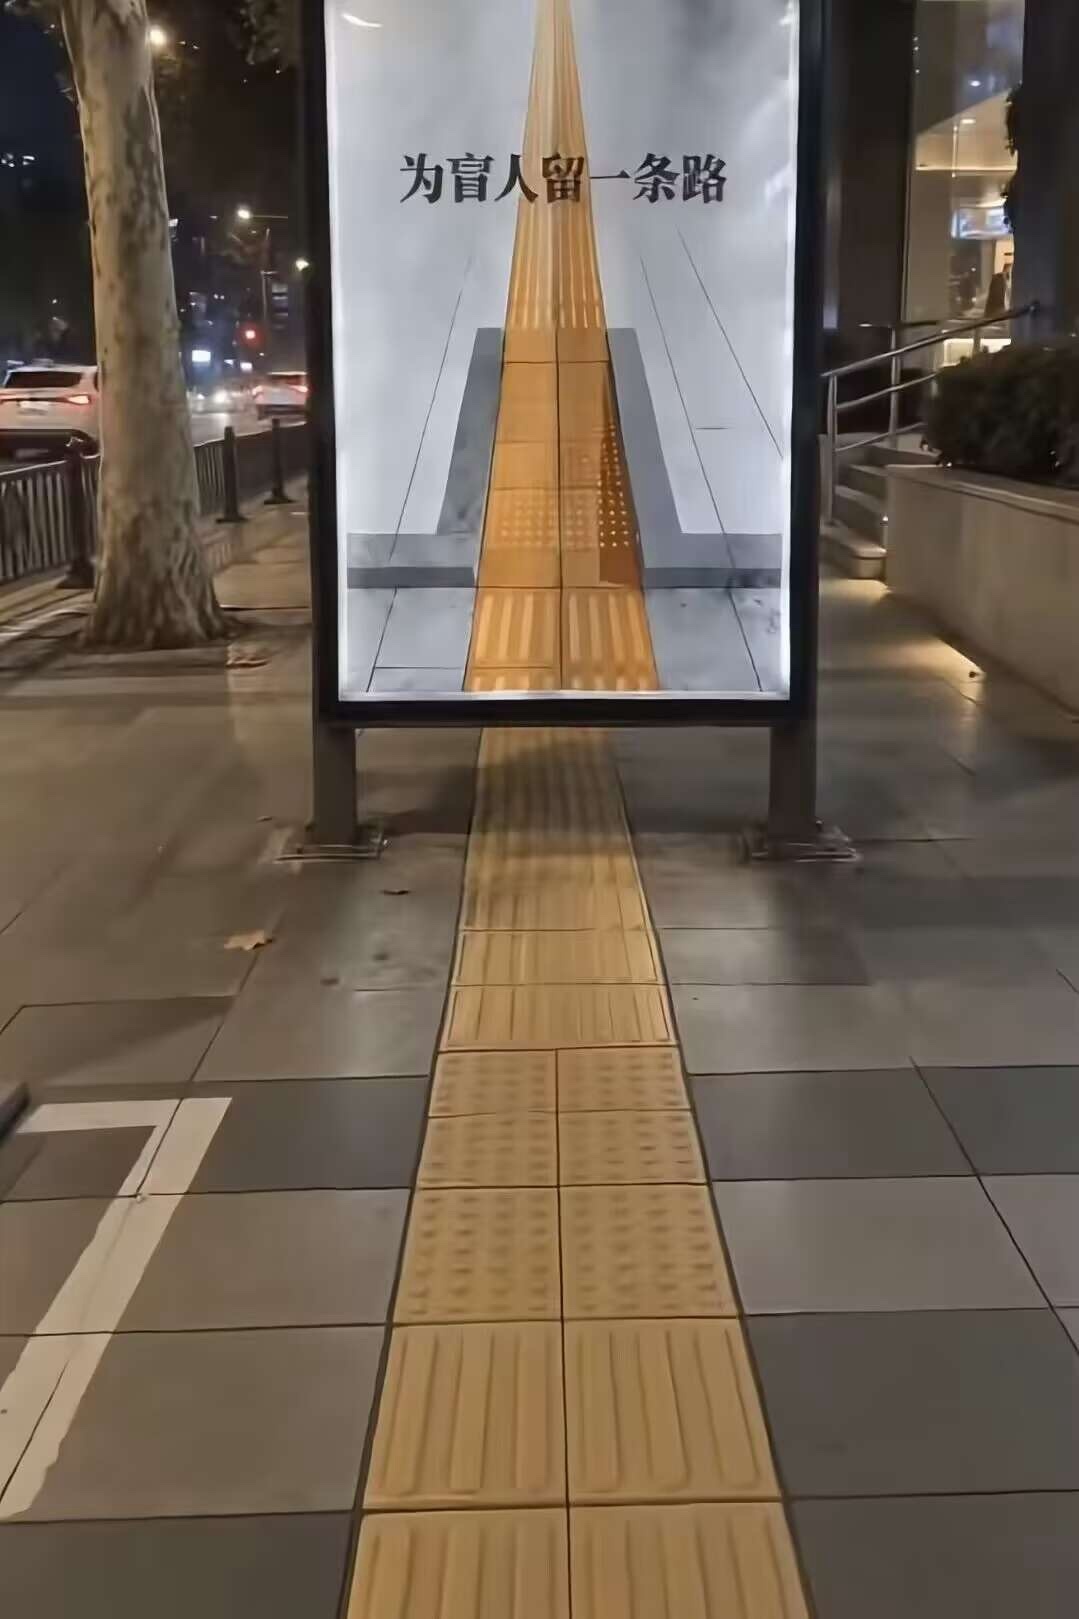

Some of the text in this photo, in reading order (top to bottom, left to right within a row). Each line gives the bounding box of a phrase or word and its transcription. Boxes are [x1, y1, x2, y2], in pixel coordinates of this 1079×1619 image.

[400, 152, 727, 203] 为盲人留一条路
